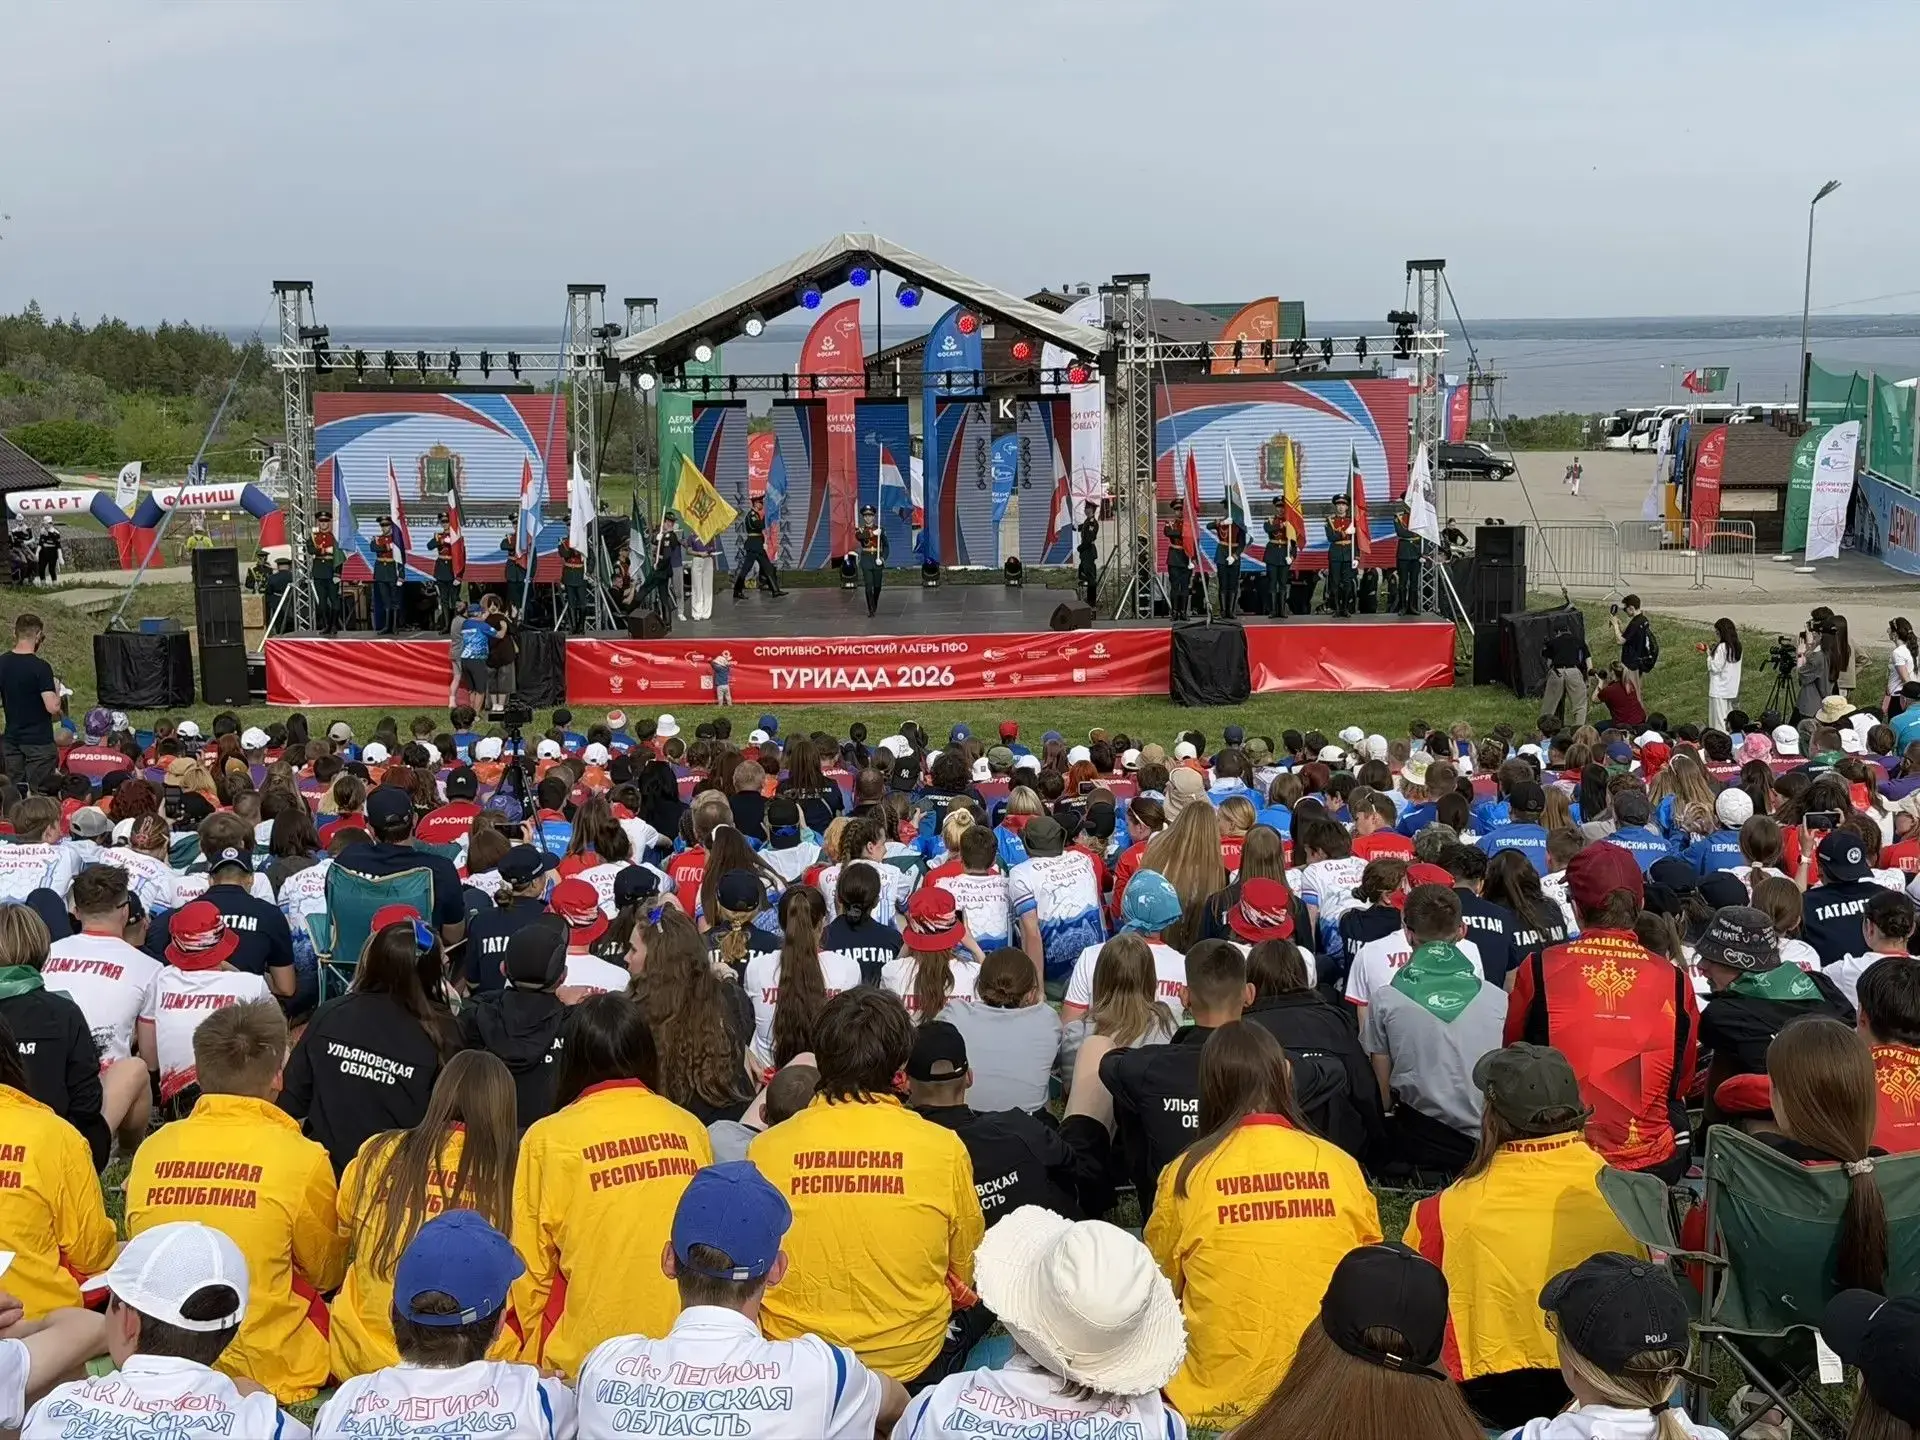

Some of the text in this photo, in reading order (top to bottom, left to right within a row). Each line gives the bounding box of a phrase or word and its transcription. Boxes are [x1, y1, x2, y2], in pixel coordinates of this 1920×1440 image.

[19, 496, 83, 511] СТАРТ
[163, 489, 235, 507] ФИНИШ
[753, 642, 969, 657] СПОРТИВНО-ТУРИСТСКИЙ ЛАГЕРЬ ПФО
[769, 665, 956, 692] ТУРИАДА 2026
[1495, 837, 1540, 848] ПЕРМСКИЙ
[1566, 946, 1650, 961] РЕСПУБЛИКА
[40, 957, 125, 982] УДМУРТИЯ
[160, 991, 236, 1010] УДМУРТИЯ
[326, 1041, 415, 1080] УЛЬЯНОВСКАЯ
[340, 1060, 397, 1086] ОБЛАСТЬ
[582, 1132, 690, 1164] ЧУВАШСКАЯ
[793, 1149, 904, 1170] ЧУВАШСКАЯ
[154, 1160, 264, 1184] ЧУВАШСКАЯ
[589, 1157, 699, 1192] РЕСПУБЛИКА
[1215, 1170, 1331, 1197] ЧУВАШСКАЯ
[790, 1174, 905, 1196] РЕСПУБЛИКА
[145, 1186, 258, 1210] РЕСПУБЛИКА
[1217, 1197, 1337, 1226] РЕСПУБЛИКА
[1644, 1333, 1669, 1345] POLO
[661, 1359, 781, 1386] ЛЕГИОН
[596, 1378, 793, 1411] ИВАНОВСКАЯ
[612, 1407, 752, 1437] ОБЛАСТЬ
